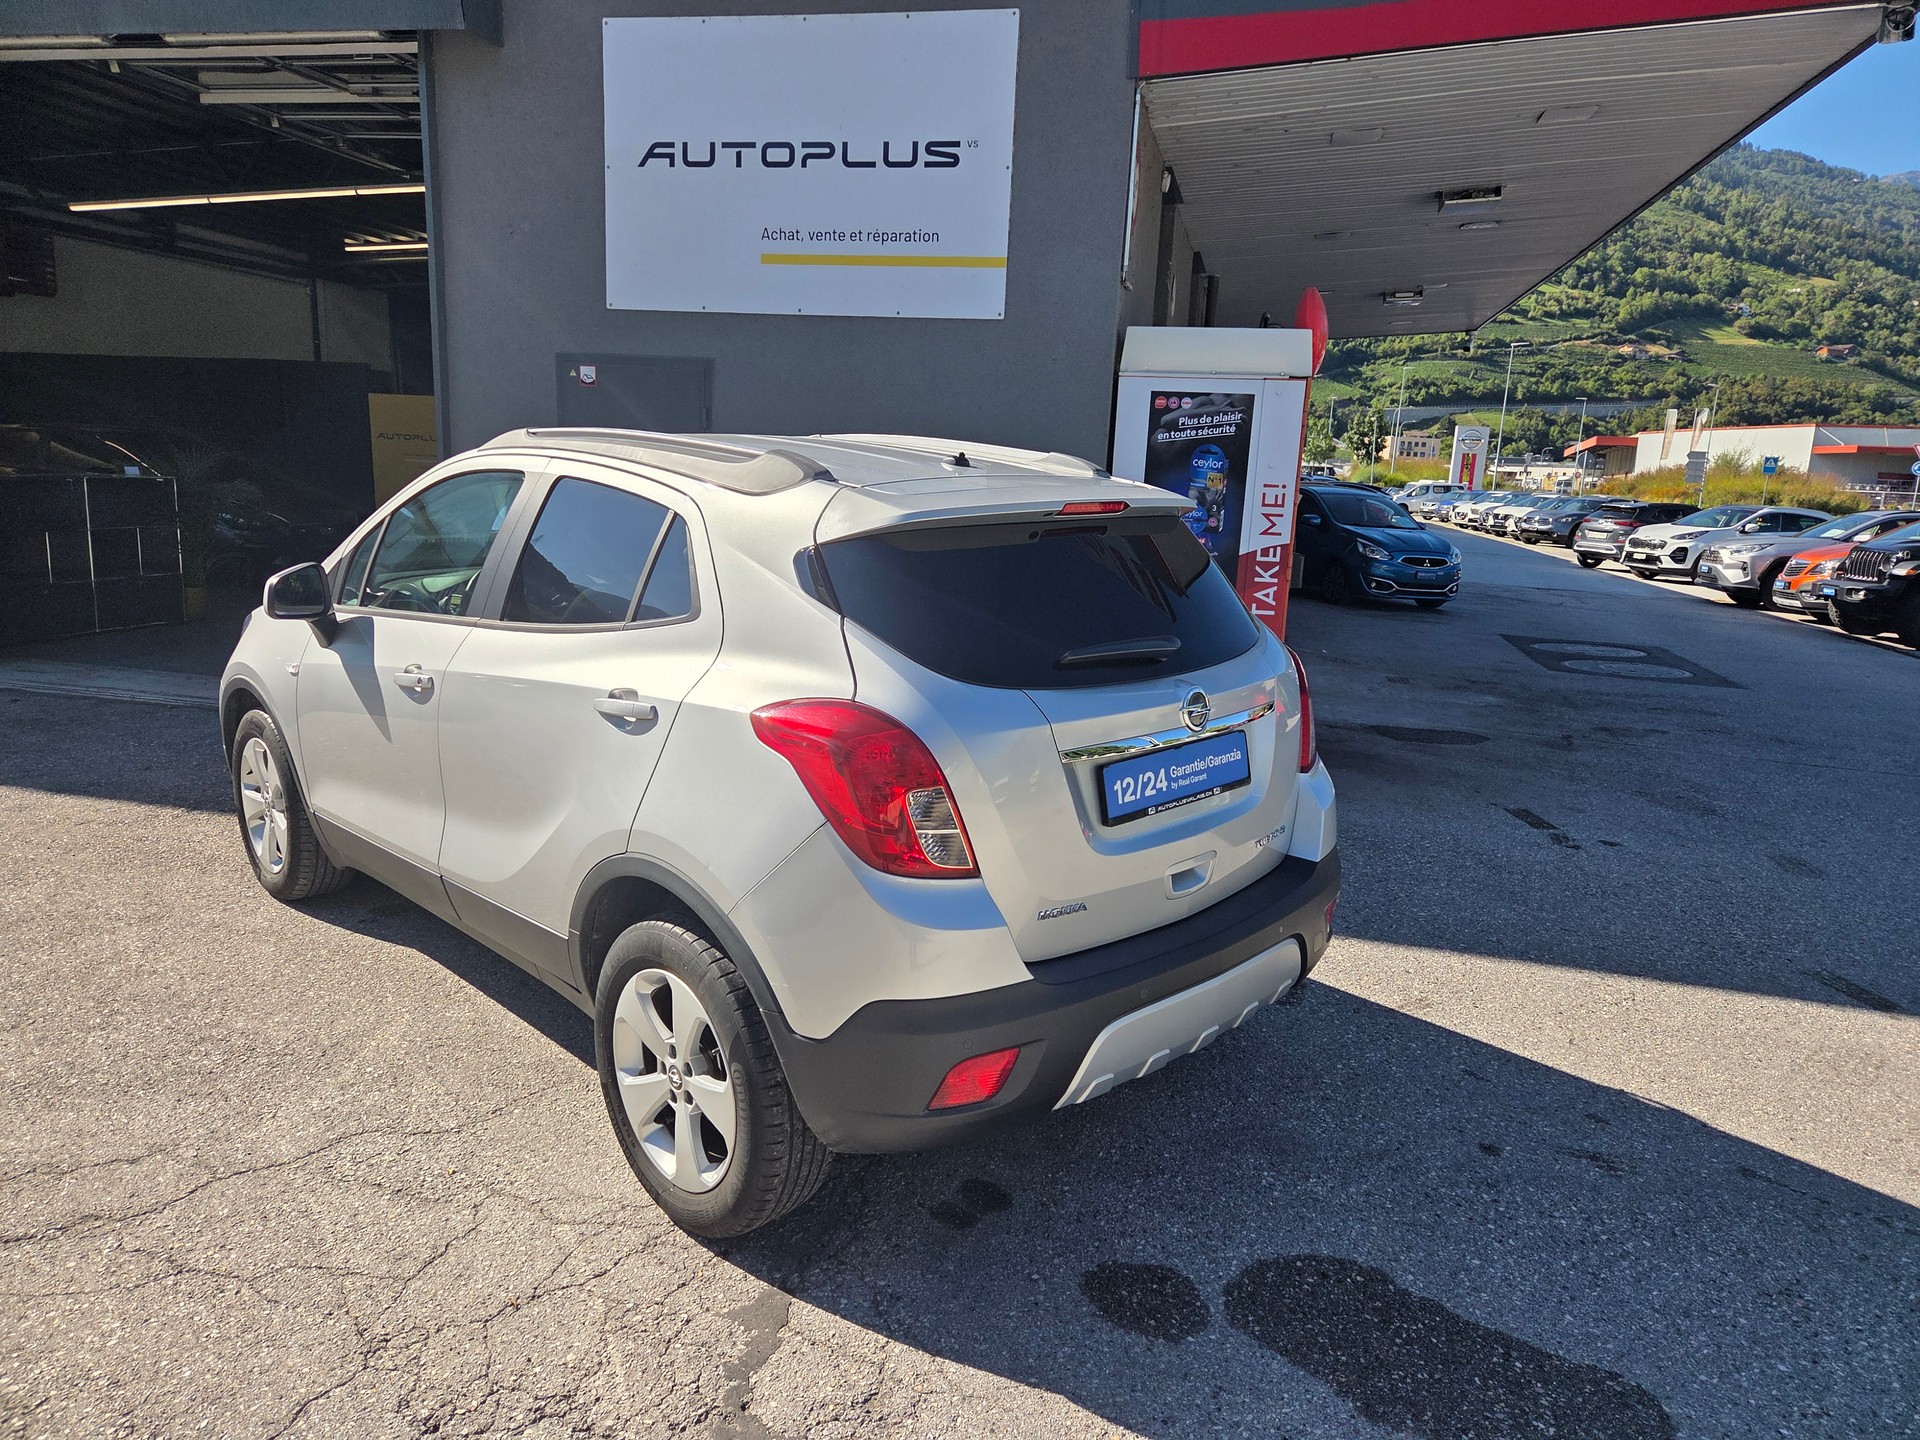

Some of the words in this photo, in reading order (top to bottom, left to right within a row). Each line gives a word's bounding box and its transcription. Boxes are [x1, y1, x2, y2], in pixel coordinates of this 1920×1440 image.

[637, 140, 961, 169] AUTOPLUS
[967, 140, 979, 148] VS
[761, 227, 804, 242] Achat,
[808, 230, 846, 242] vente
[850, 231, 863, 242] et
[867, 228, 940, 245] réparation
[1179, 416, 1198, 426] Plus
[1200, 414, 1212, 424] de
[1213, 411, 1242, 424] plaisir
[376, 432, 437, 442] AUTOPLU
[1157, 432, 1169, 440] en
[1171, 429, 1197, 438] toute
[1198, 424, 1236, 436] sécurité
[1192, 458, 1223, 469] ceylor
[1258, 483, 1287, 537] ME!
[1251, 546, 1282, 616] TAKE
[1170, 748, 1242, 778] Garantie/Garanzia
[1113, 768, 1168, 805] 12/24
[1171, 781, 1178, 789] by
[1179, 777, 1190, 786] Real
[1190, 773, 1208, 783] Garant
